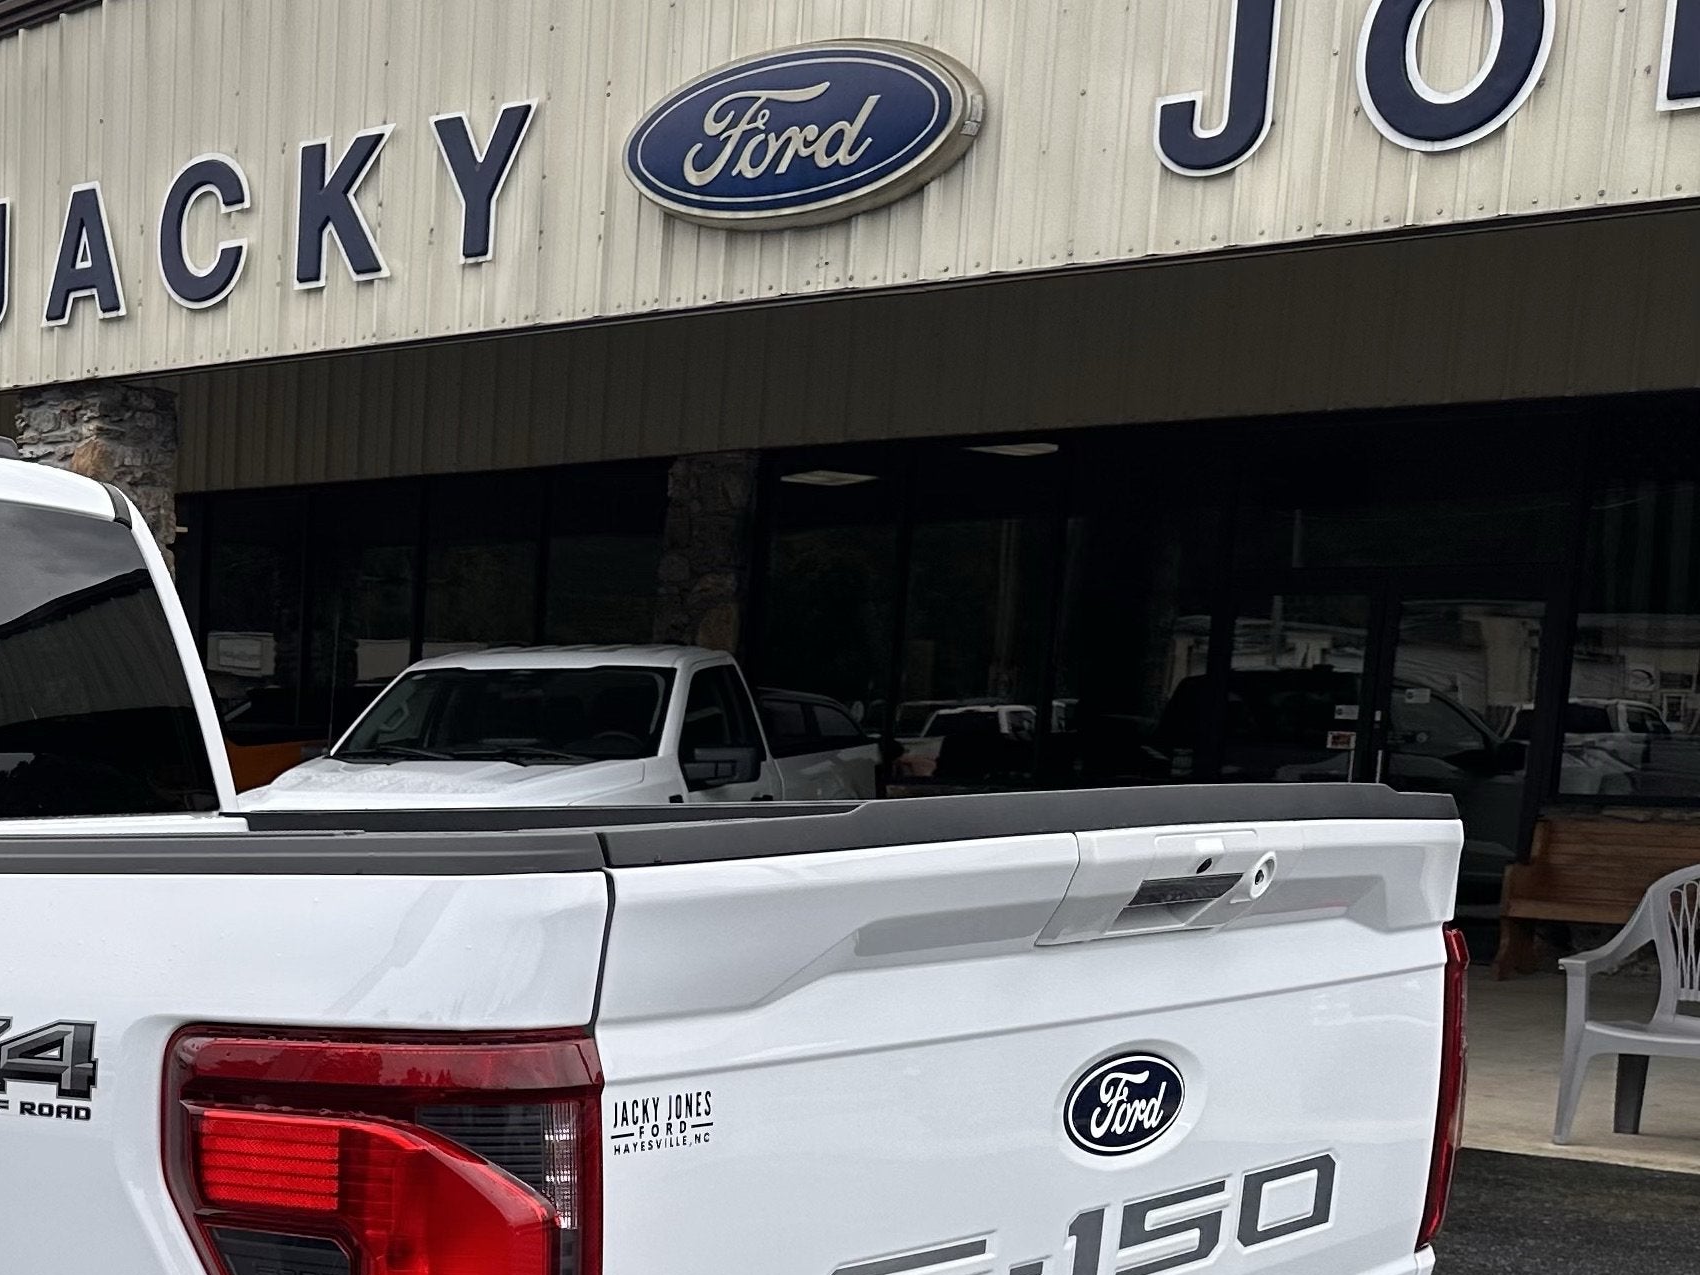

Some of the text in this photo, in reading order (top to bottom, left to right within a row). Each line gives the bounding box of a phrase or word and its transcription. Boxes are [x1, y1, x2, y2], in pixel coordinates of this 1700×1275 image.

[1153, 0, 1700, 177] JO
[683, 81, 882, 186] Ford
[19, 1100, 92, 1121] ROAD
[613, 1090, 712, 1129] JACKY JONES
[1090, 1071, 1168, 1138] Ford
[639, 1120, 687, 1140] FORD
[694, 1132, 711, 1145] NC
